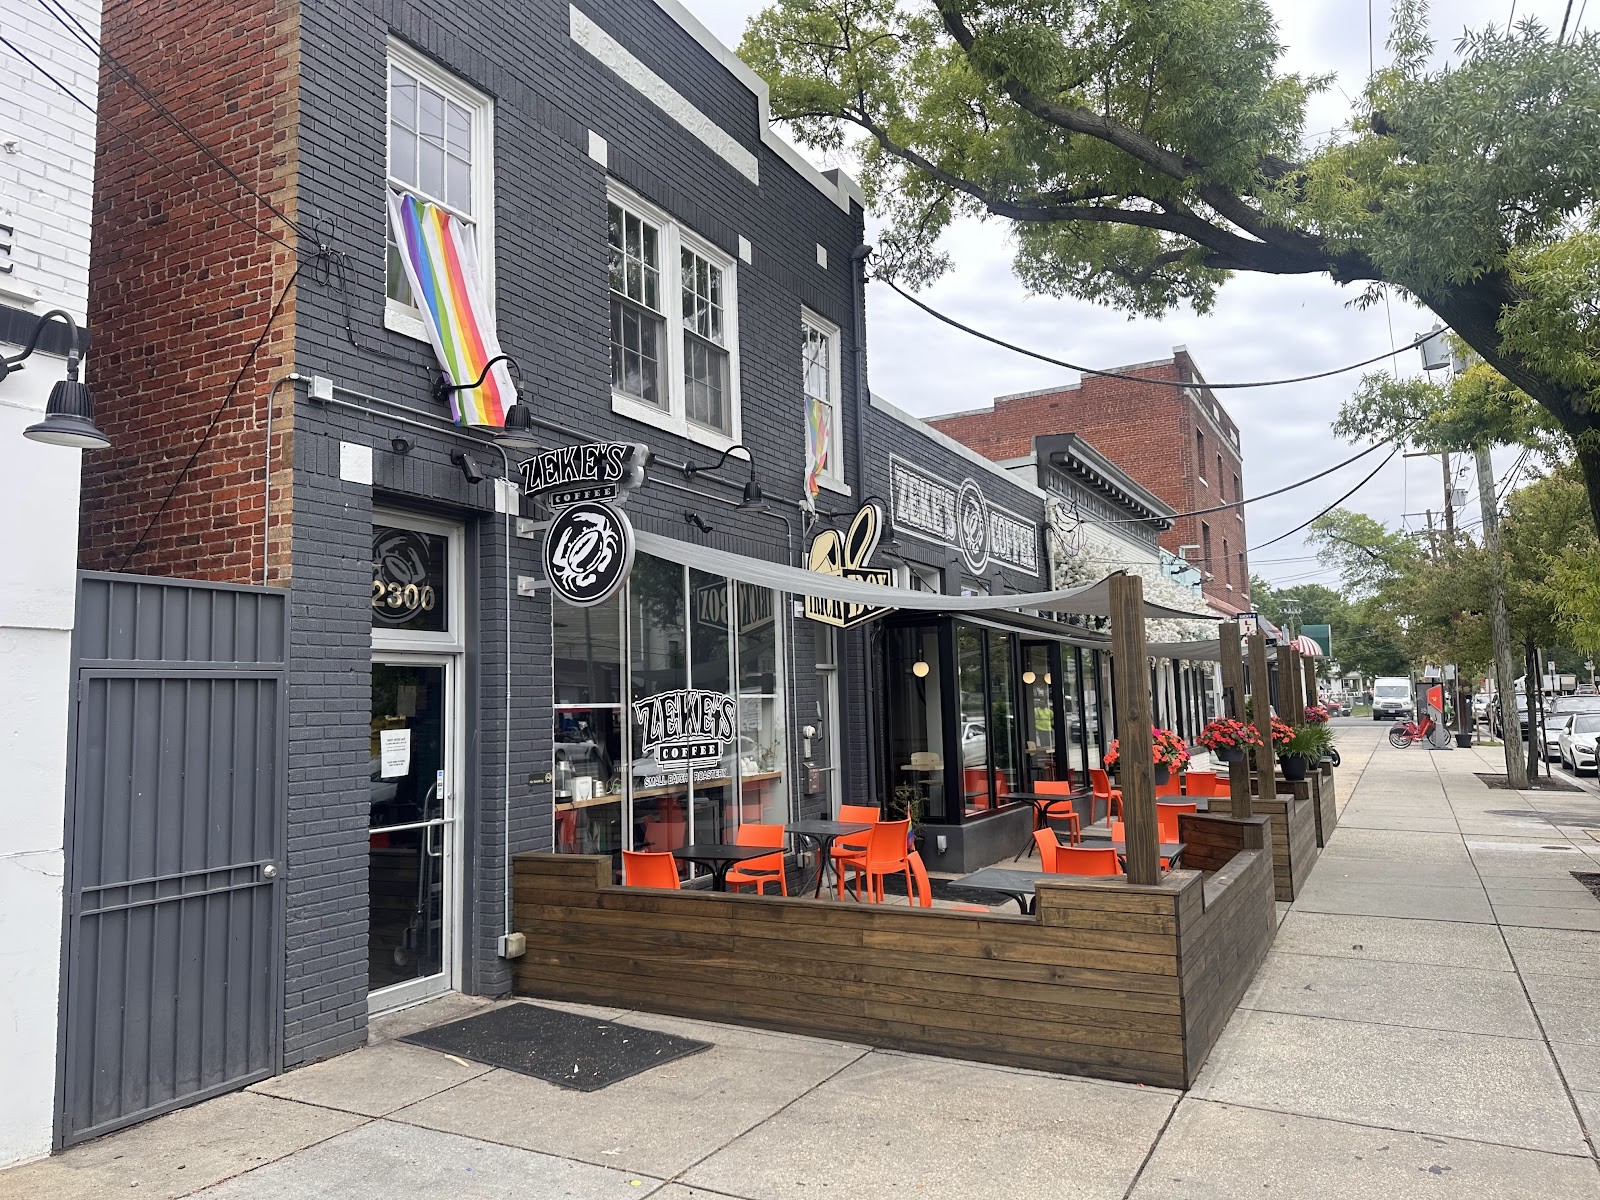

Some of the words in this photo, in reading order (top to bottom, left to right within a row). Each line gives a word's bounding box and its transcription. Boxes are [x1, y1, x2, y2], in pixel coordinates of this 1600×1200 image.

[517, 443, 628, 495] ZEKE'S
[555, 487, 612, 503] COFFEE
[990, 511, 1036, 570] COFFEE
[371, 579, 436, 611] 2300
[633, 689, 737, 753] ZEKE'S
[662, 744, 716, 759] COFFEE
[644, 775, 667, 788] SMALL
[667, 772, 689, 785] BATCH
[694, 767, 727, 782] ROASTERY
